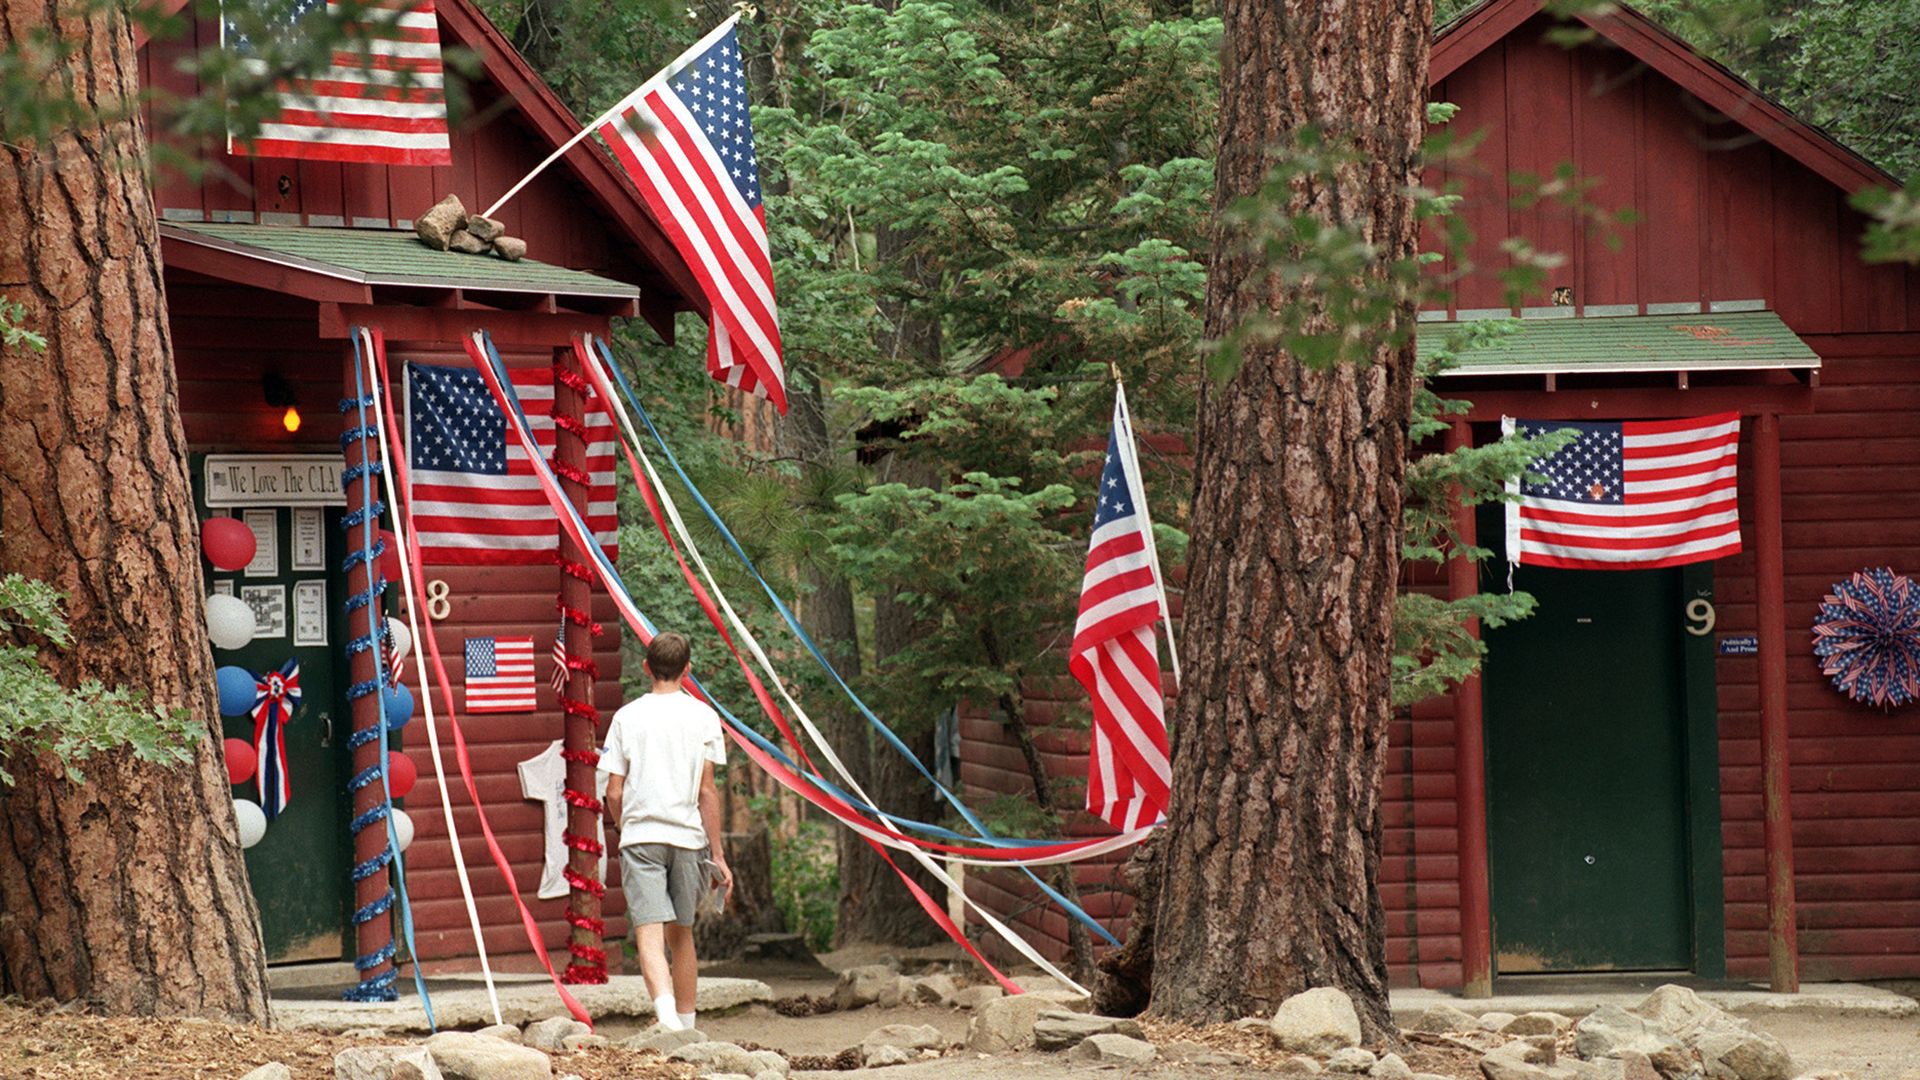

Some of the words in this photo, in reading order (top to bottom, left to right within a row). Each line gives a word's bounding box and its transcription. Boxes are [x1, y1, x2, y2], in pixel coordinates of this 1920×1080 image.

[228, 466, 246, 493] We
[251, 466, 277, 494] Love
[281, 466, 304, 493] The
[427, 579, 451, 620] 8
[1686, 598, 1716, 636] 9
[1722, 638, 1751, 646] Politically
